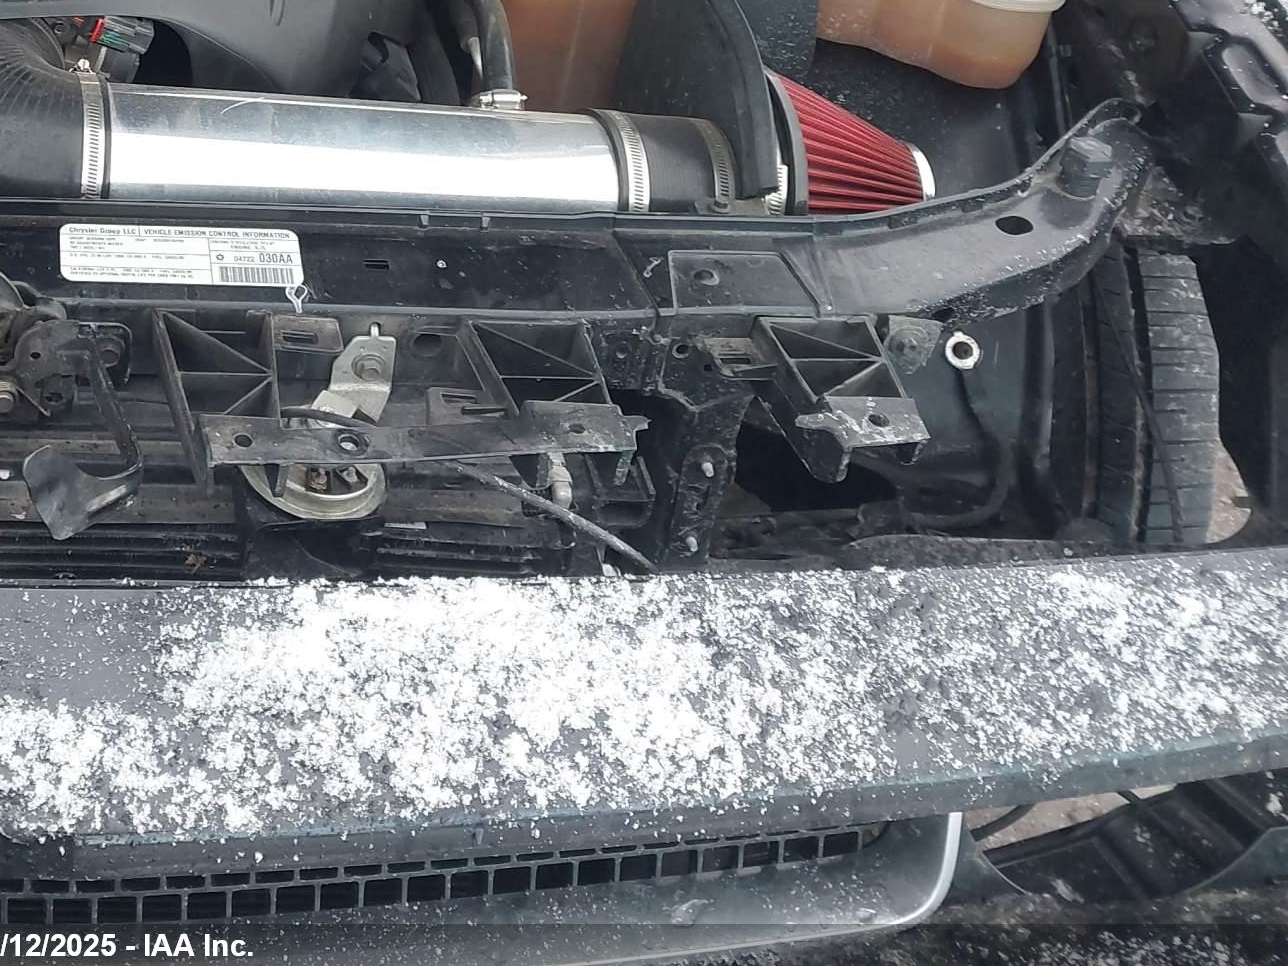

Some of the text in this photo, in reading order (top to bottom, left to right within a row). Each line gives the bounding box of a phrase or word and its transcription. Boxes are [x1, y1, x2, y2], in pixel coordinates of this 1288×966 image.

[69, 227, 98, 235] Chrysler
[242, 231, 290, 239] INFORMATION
[258, 253, 293, 264] 030AA
